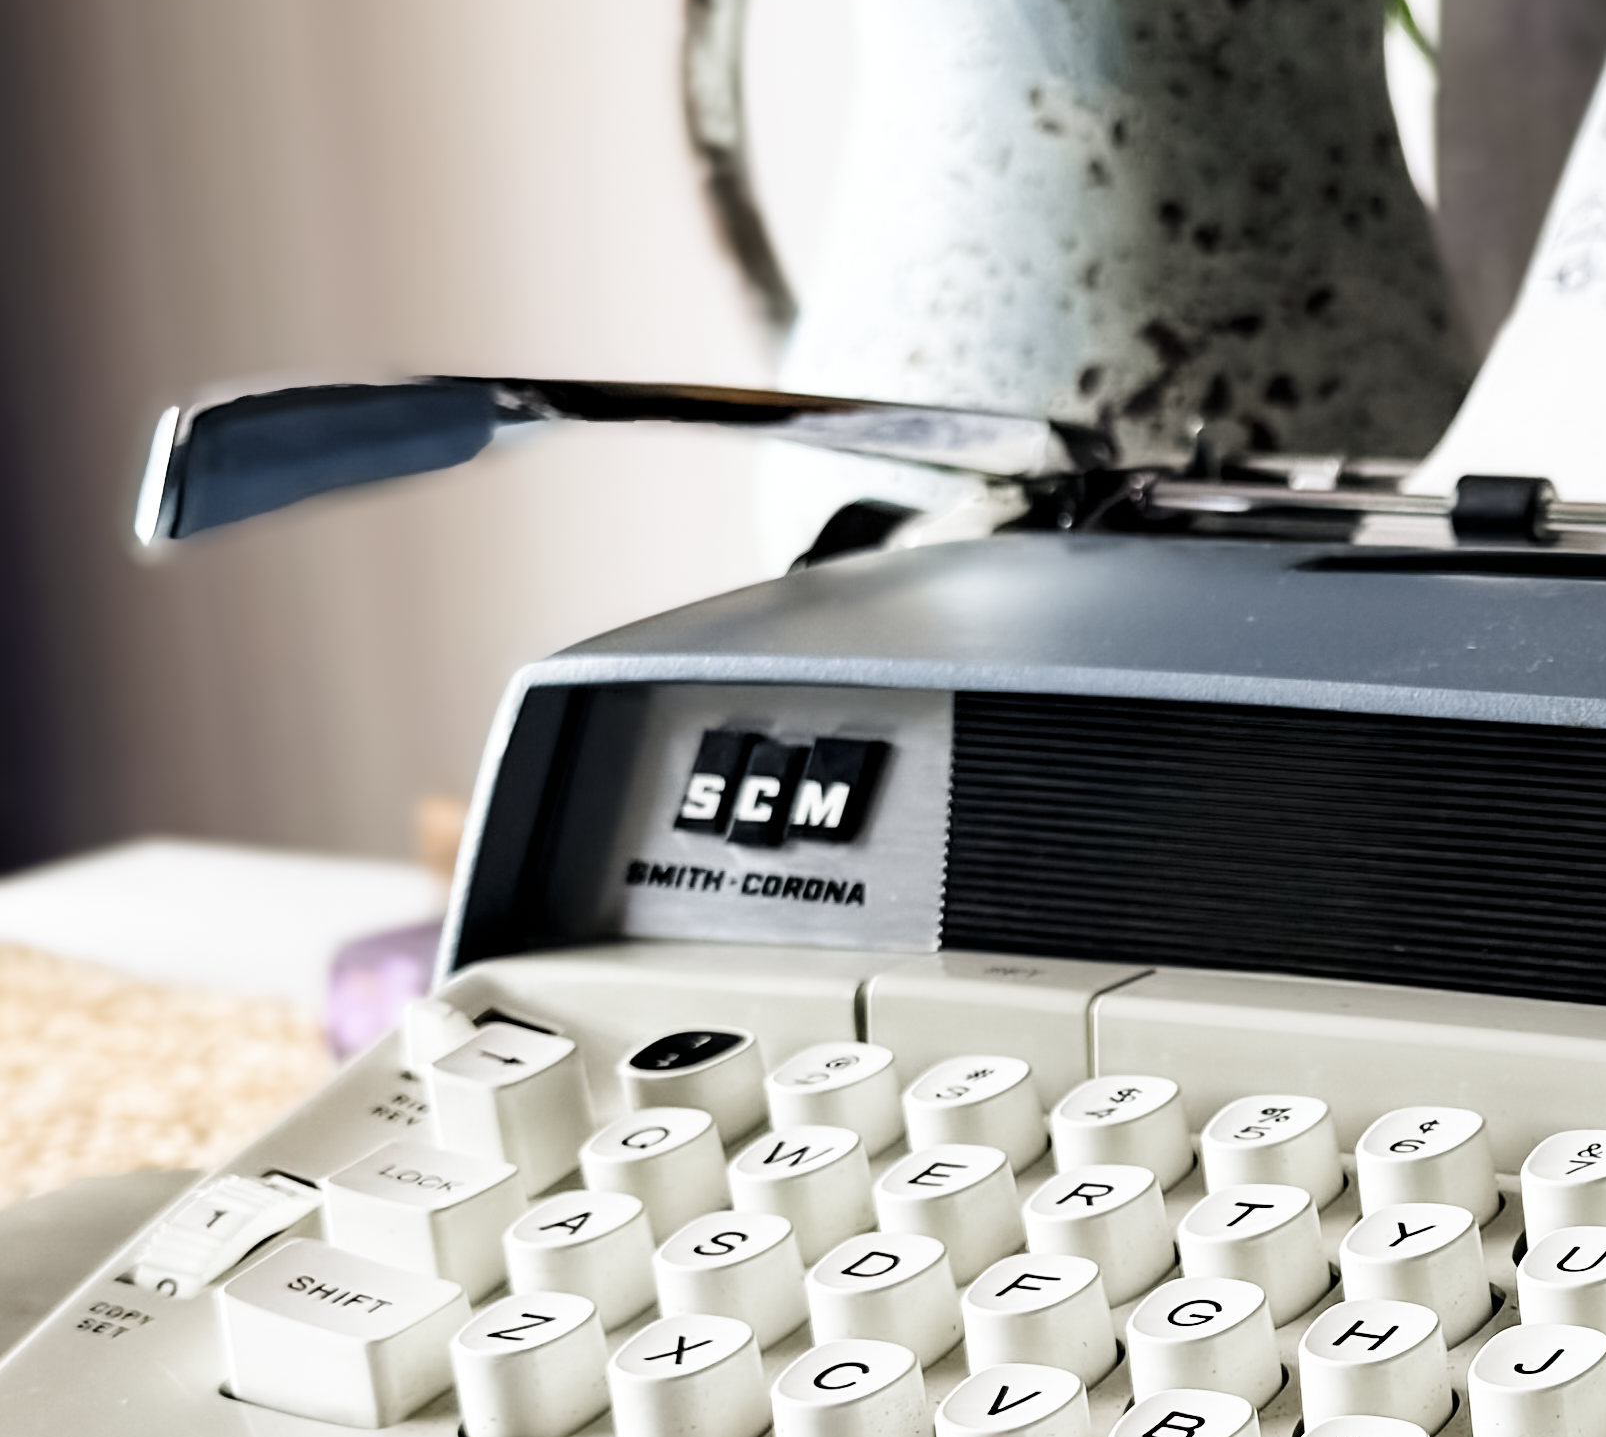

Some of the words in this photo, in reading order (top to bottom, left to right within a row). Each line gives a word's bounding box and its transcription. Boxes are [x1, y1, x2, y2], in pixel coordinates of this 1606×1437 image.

[682, 773, 850, 828] SCM
[1260, 1108, 1290, 1122] %
[622, 1127, 669, 1149] Q
[1234, 1126, 1271, 1140] 5
[763, 1141, 834, 1168] W
[1390, 1140, 1425, 1152] 6
[1578, 1144, 1601, 1158] &
[378, 1164, 464, 1192] LOCK
[908, 1163, 964, 1185] E
[1566, 1160, 1597, 1175] 7
[1056, 1183, 1114, 1206] R
[540, 1212, 593, 1240] A
[1227, 1202, 1274, 1226] T
[694, 1232, 748, 1255] S
[1389, 1223, 1435, 1246] Y
[841, 1252, 900, 1277] D
[287, 1276, 391, 1312] SHIFT
[995, 1273, 1062, 1298] F
[1168, 1300, 1222, 1326] G
[76, 1317, 130, 1339] SET
[487, 1314, 554, 1340] Z
[1333, 1321, 1398, 1350] H
[645, 1336, 712, 1364] X
[1514, 1349, 1564, 1374] J
[814, 1363, 869, 1389] C
[988, 1386, 1041, 1415] V
